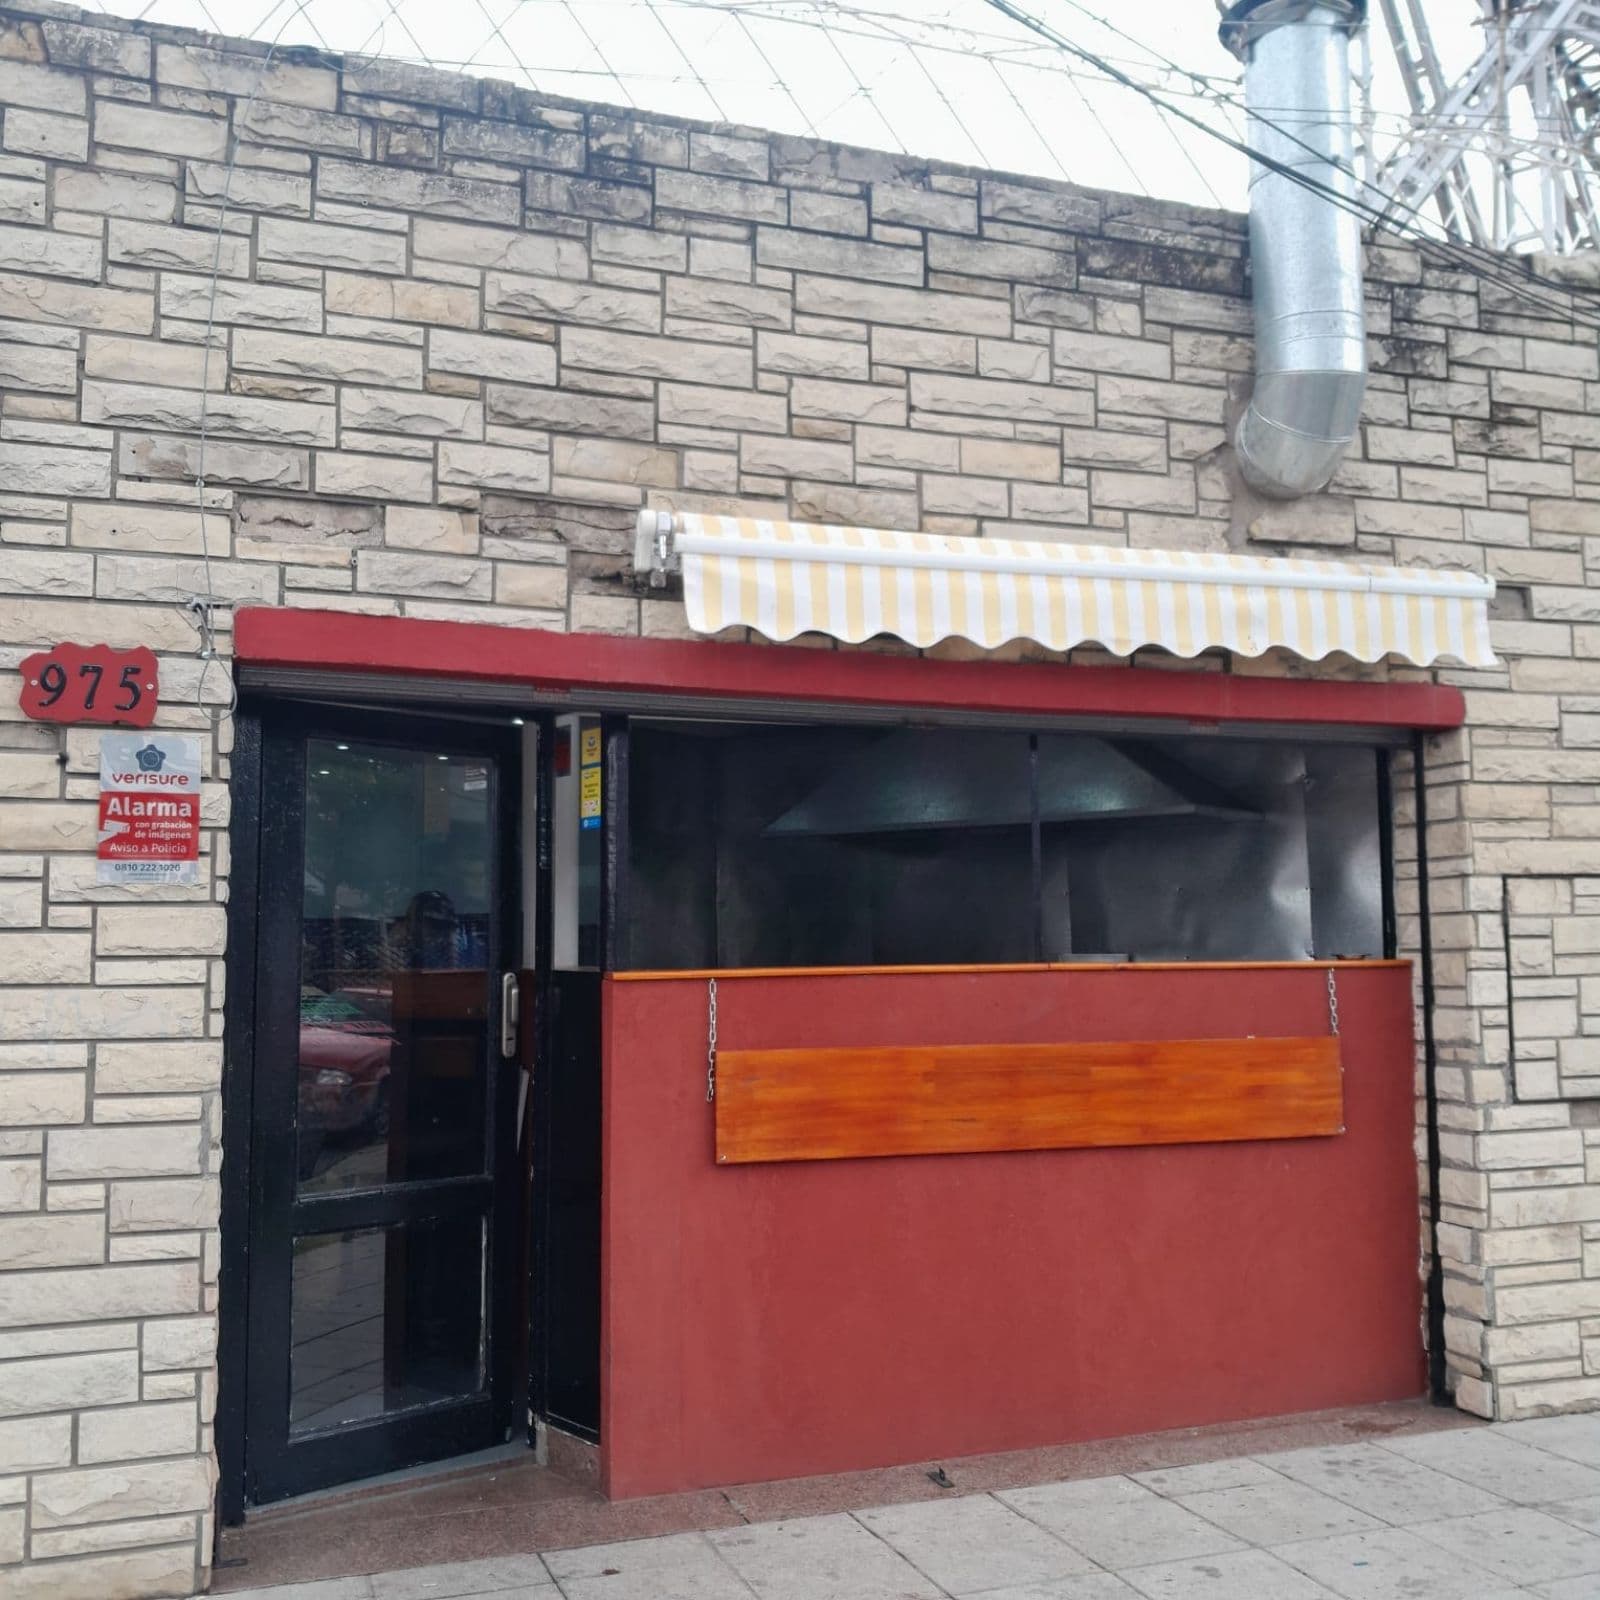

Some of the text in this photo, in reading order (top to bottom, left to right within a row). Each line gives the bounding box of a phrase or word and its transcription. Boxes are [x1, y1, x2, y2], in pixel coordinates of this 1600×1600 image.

[38, 663, 142, 711] 975
[112, 772, 190, 785] verisure
[107, 796, 192, 817] Alarma
[134, 830, 145, 838] de
[109, 843, 137, 852] Aviso
